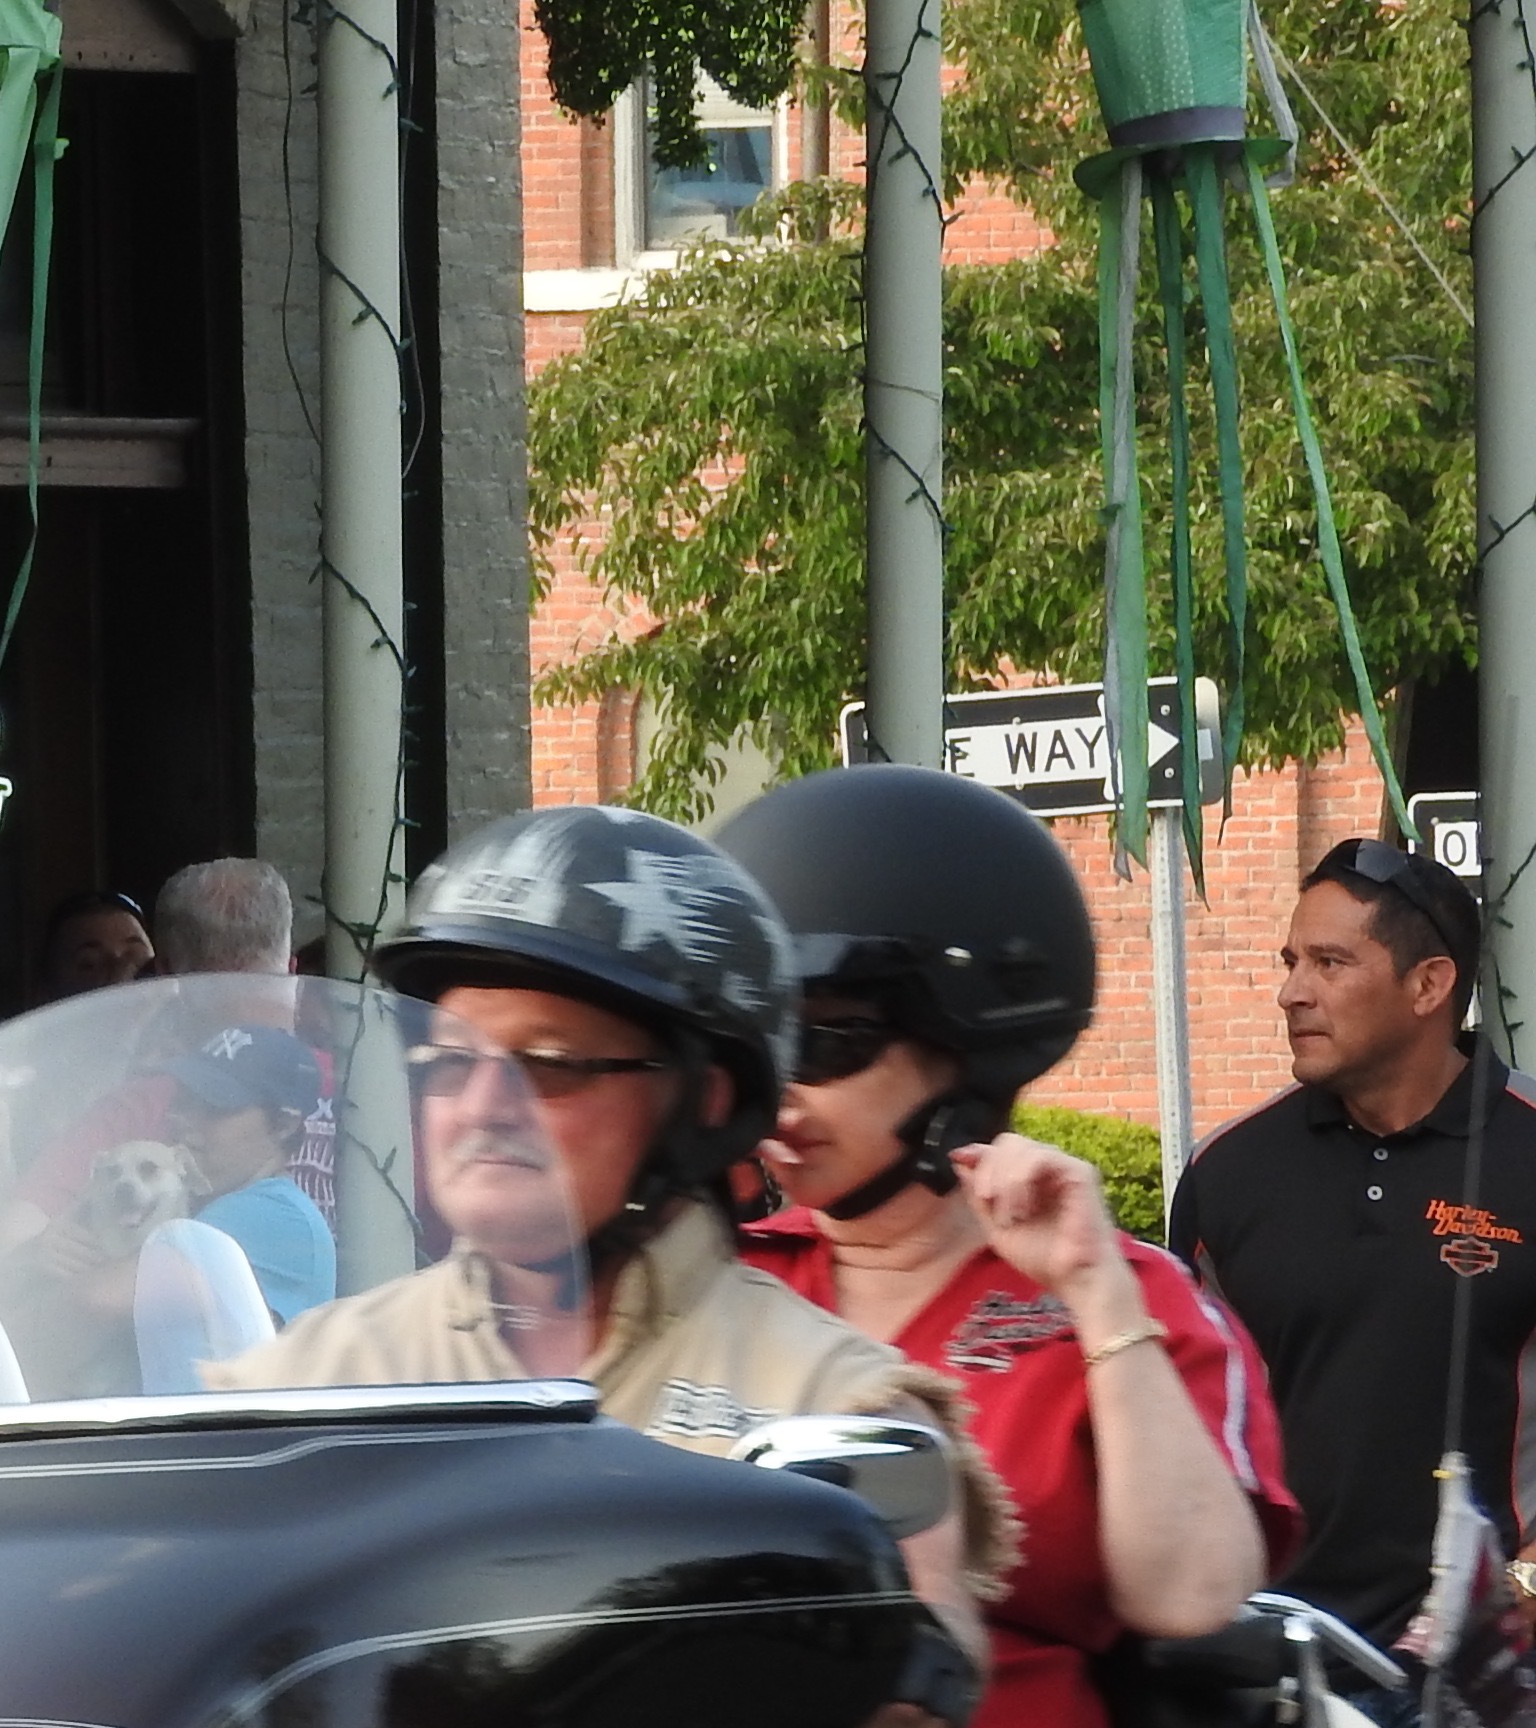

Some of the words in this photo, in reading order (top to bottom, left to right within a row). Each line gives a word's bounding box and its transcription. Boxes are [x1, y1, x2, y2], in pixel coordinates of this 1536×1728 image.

[1005, 725, 1105, 775] WAY
[1442, 830, 1467, 867] O
[1426, 1199, 1497, 1221] Harley-
[1433, 1217, 1523, 1244] Davidson
